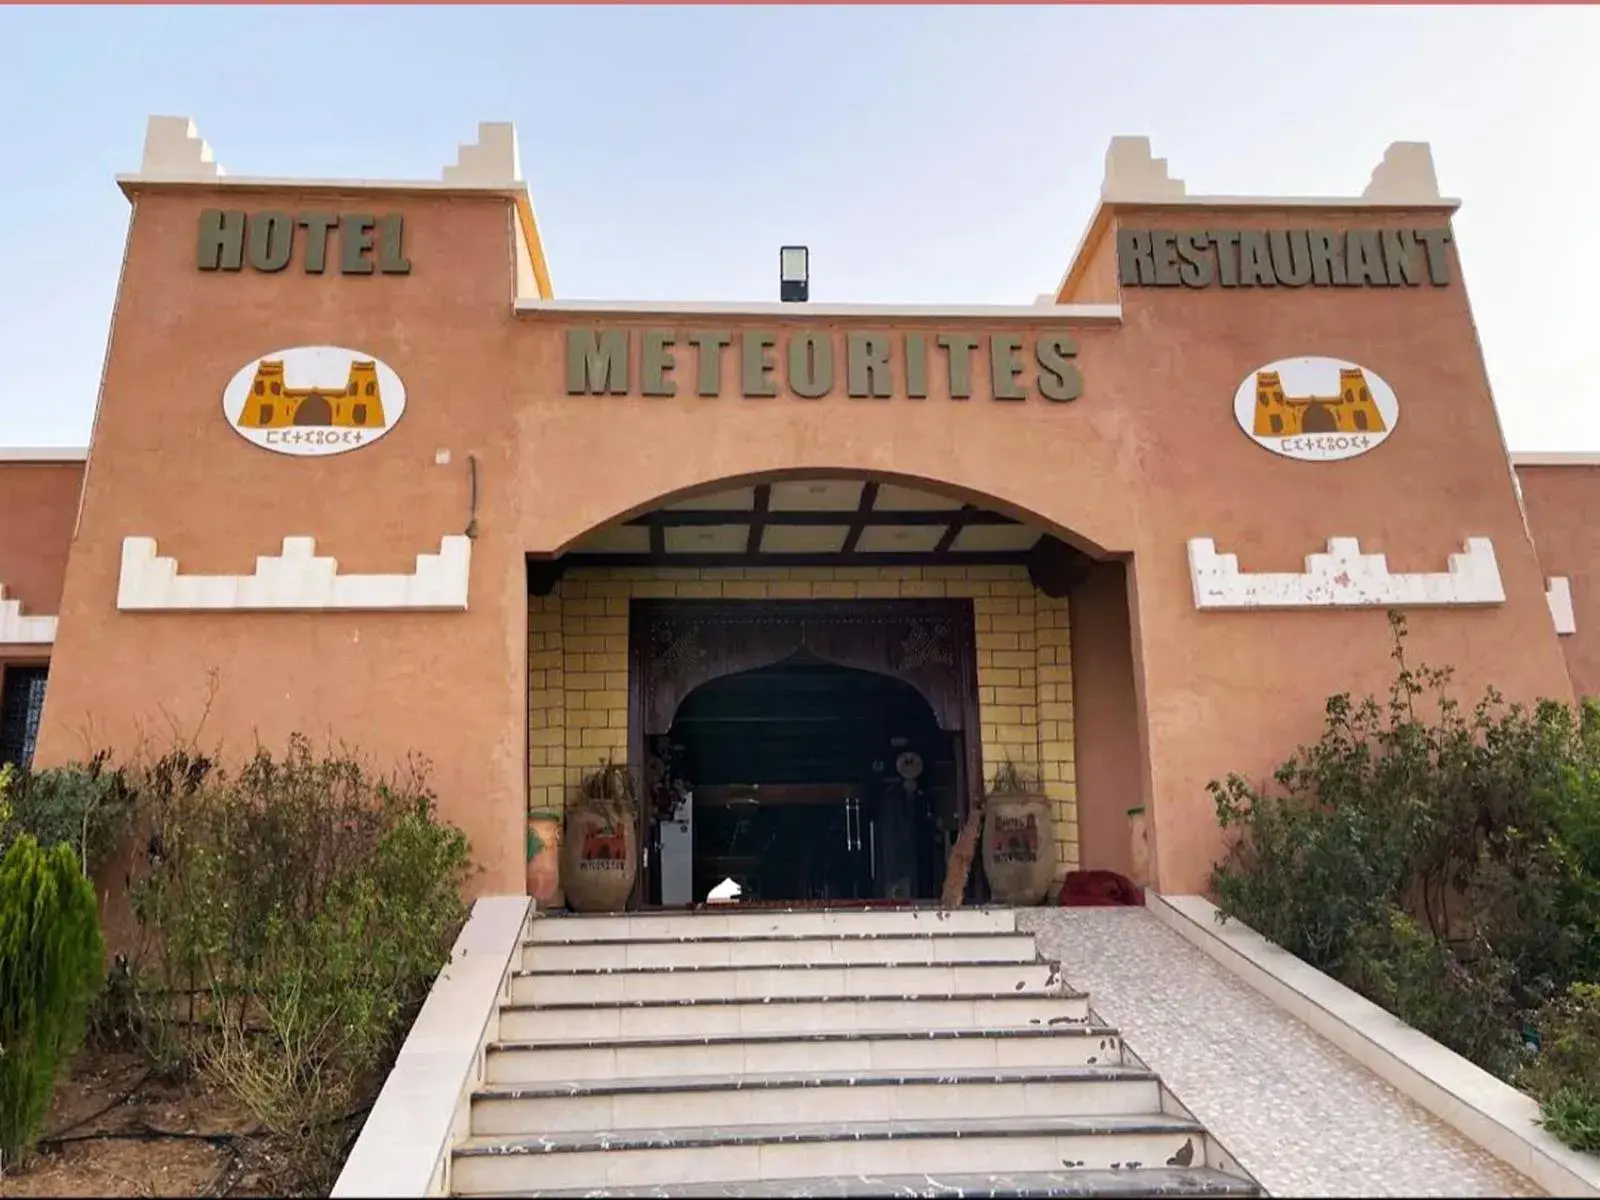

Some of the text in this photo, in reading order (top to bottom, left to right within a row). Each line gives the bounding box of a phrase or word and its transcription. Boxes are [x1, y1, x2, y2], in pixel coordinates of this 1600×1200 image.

[198, 210, 411, 275] HOTEL
[1118, 228, 1451, 288] RESTAURANT
[567, 326, 1082, 401] METEORITES
